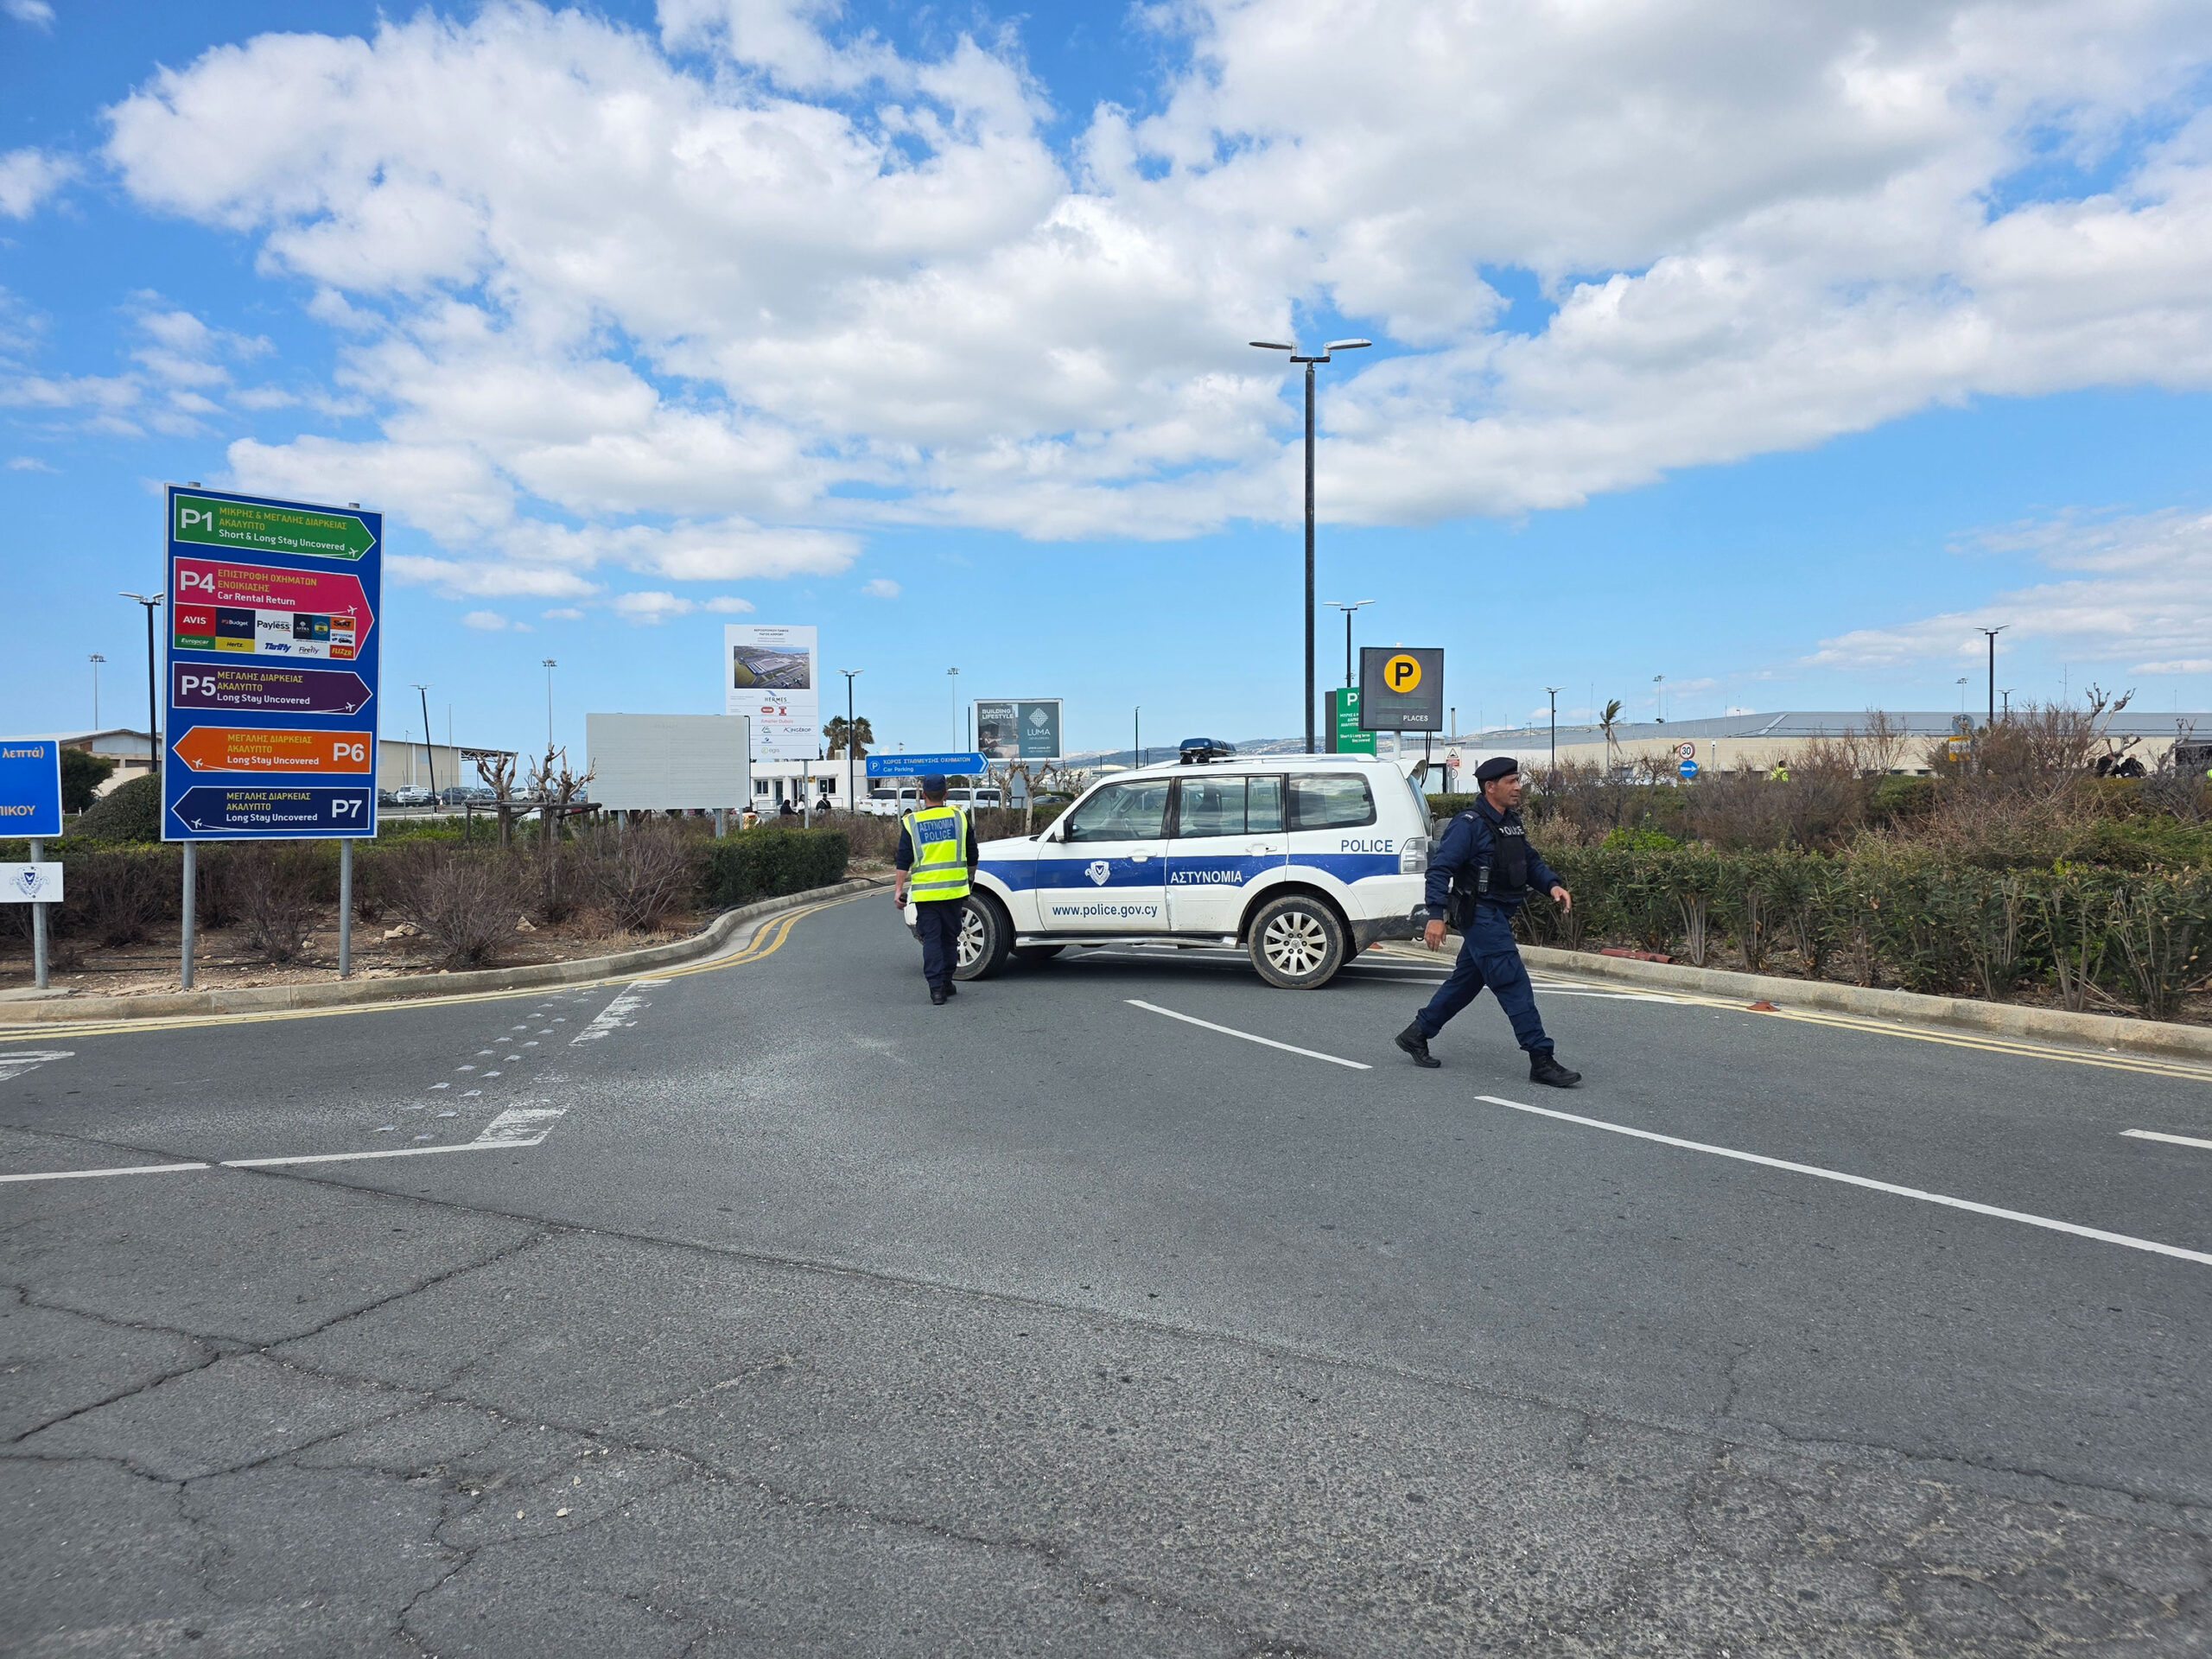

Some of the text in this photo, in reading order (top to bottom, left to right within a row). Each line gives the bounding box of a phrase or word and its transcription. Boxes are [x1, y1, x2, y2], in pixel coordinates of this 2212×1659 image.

[181, 508, 213, 531] P1
[219, 506, 347, 530] ΜΙΚΡΗΣ & ΜΕΓΑΛΗΣ ΔΙΑΡΚΕΙΑΣ
[219, 519, 265, 531] ΑΚΑΛΥΠΤΟ
[219, 529, 346, 551] Short & Long Stay Uncovered
[180, 570, 215, 593] P4
[218, 569, 317, 587] ΕΠΙΣΤΡΟΦΗ ΟΧΗΜΑΤΩΝ
[218, 581, 270, 593] ΕΝΟΙΚΙΑΣΗΣ
[218, 591, 296, 606] Car Rental Return
[182, 615, 207, 625] AVIS
[257, 620, 290, 631] Payless
[181, 637, 209, 645] Europcar
[298, 645, 320, 654] Firefly
[217, 671, 303, 683] ΜΕΓΑΛΗΣ ΔΙΑΡΚΕΙΑΣ
[1395, 662, 1414, 687] P
[181, 675, 216, 696] P5
[217, 682, 263, 692] ΑΚΑΛΥΠΤΟ
[217, 693, 310, 705] Long Stay Uncovered
[1347, 692, 1359, 707] P
[227, 734, 313, 744] ΜΕΓΑΛΗΣ ΔΙΑΡΚΕΙΑΣ
[3, 746, 45, 759] λεπτά)
[227, 744, 272, 753] ΑΚΑΛΥΠΤΟ
[333, 742, 365, 762] P6
[1681, 747, 1692, 755] 30
[227, 755, 319, 766] Long Stay Uncovered
[269, 792, 311, 801] ΔΙΑΡΚΕΙΑΣ
[226, 803, 271, 811] ΑΚΑΛΥΠΤΟ
[331, 799, 362, 818] P7
[226, 813, 318, 823] Long Stay Uncovered
[919, 819, 955, 832] ΑΣΤΥΝΟΜΙΑ
[924, 831, 952, 842] POLICE
[1340, 839, 1394, 853] POLICE
[1169, 870, 1243, 884] ΑΣΤΥΝΟΜΙΑ
[1052, 903, 1158, 918] www.police.gov.cy
